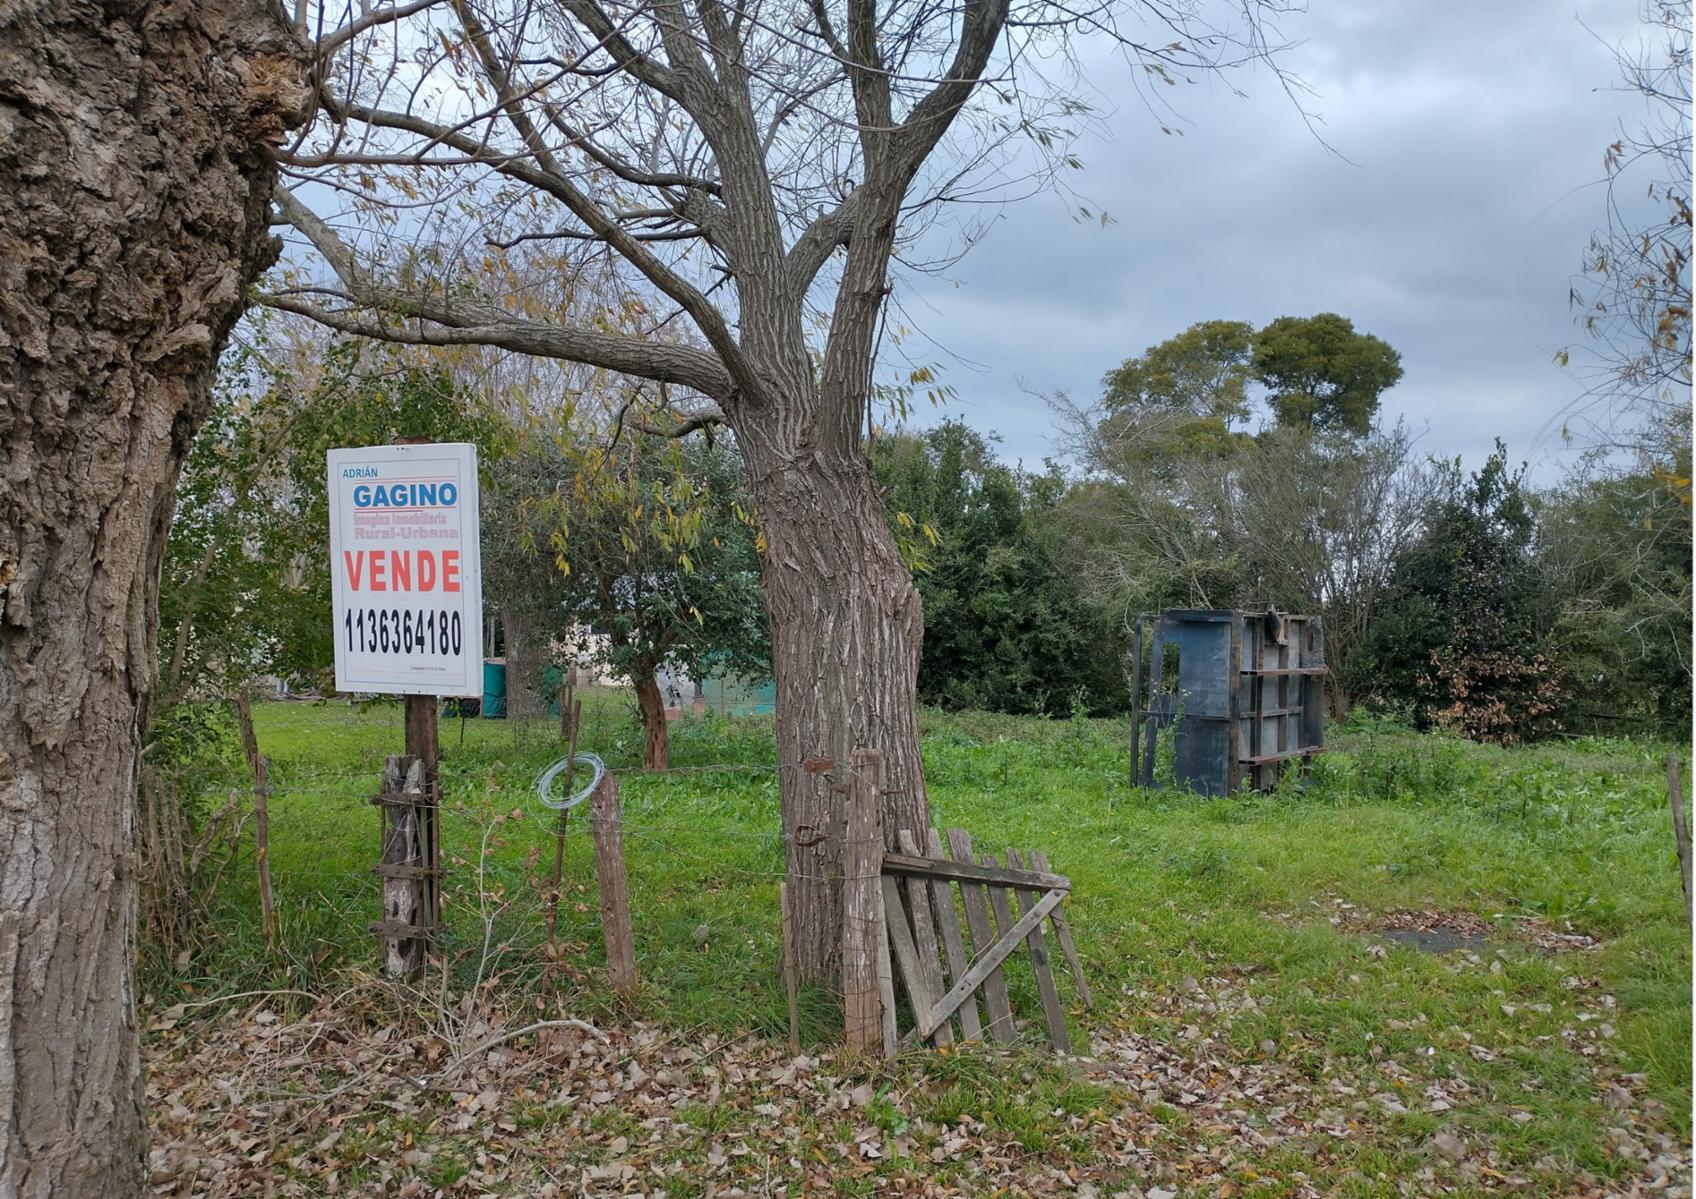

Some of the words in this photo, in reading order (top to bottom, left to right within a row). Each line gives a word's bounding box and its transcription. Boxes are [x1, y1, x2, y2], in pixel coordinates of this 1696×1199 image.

[342, 465, 378, 478] ADRIÁN
[353, 483, 457, 507] GAGINO
[355, 527, 459, 539] Rural-Urbana
[344, 550, 460, 592] VENDE
[345, 608, 461, 656] 1136364180
